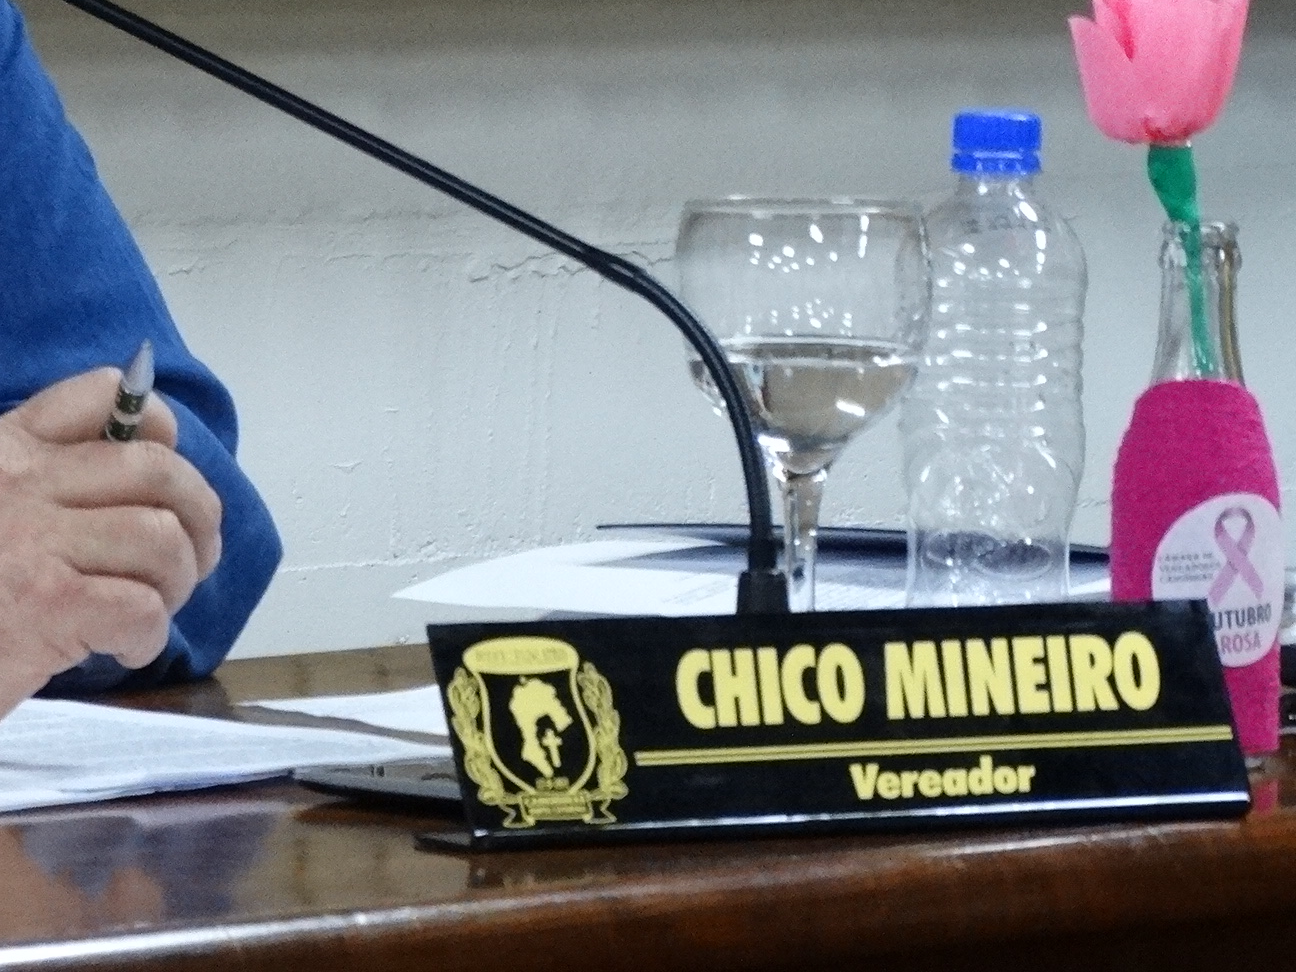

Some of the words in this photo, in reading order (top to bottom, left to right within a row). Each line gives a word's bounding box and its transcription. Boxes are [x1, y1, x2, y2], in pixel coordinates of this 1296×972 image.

[1216, 603, 1272, 630] UTUBRO
[1221, 632, 1261, 654] ROSA
[675, 642, 866, 730] CHICO
[883, 630, 1162, 721] MINEIRO
[848, 755, 1037, 801] Vereador
